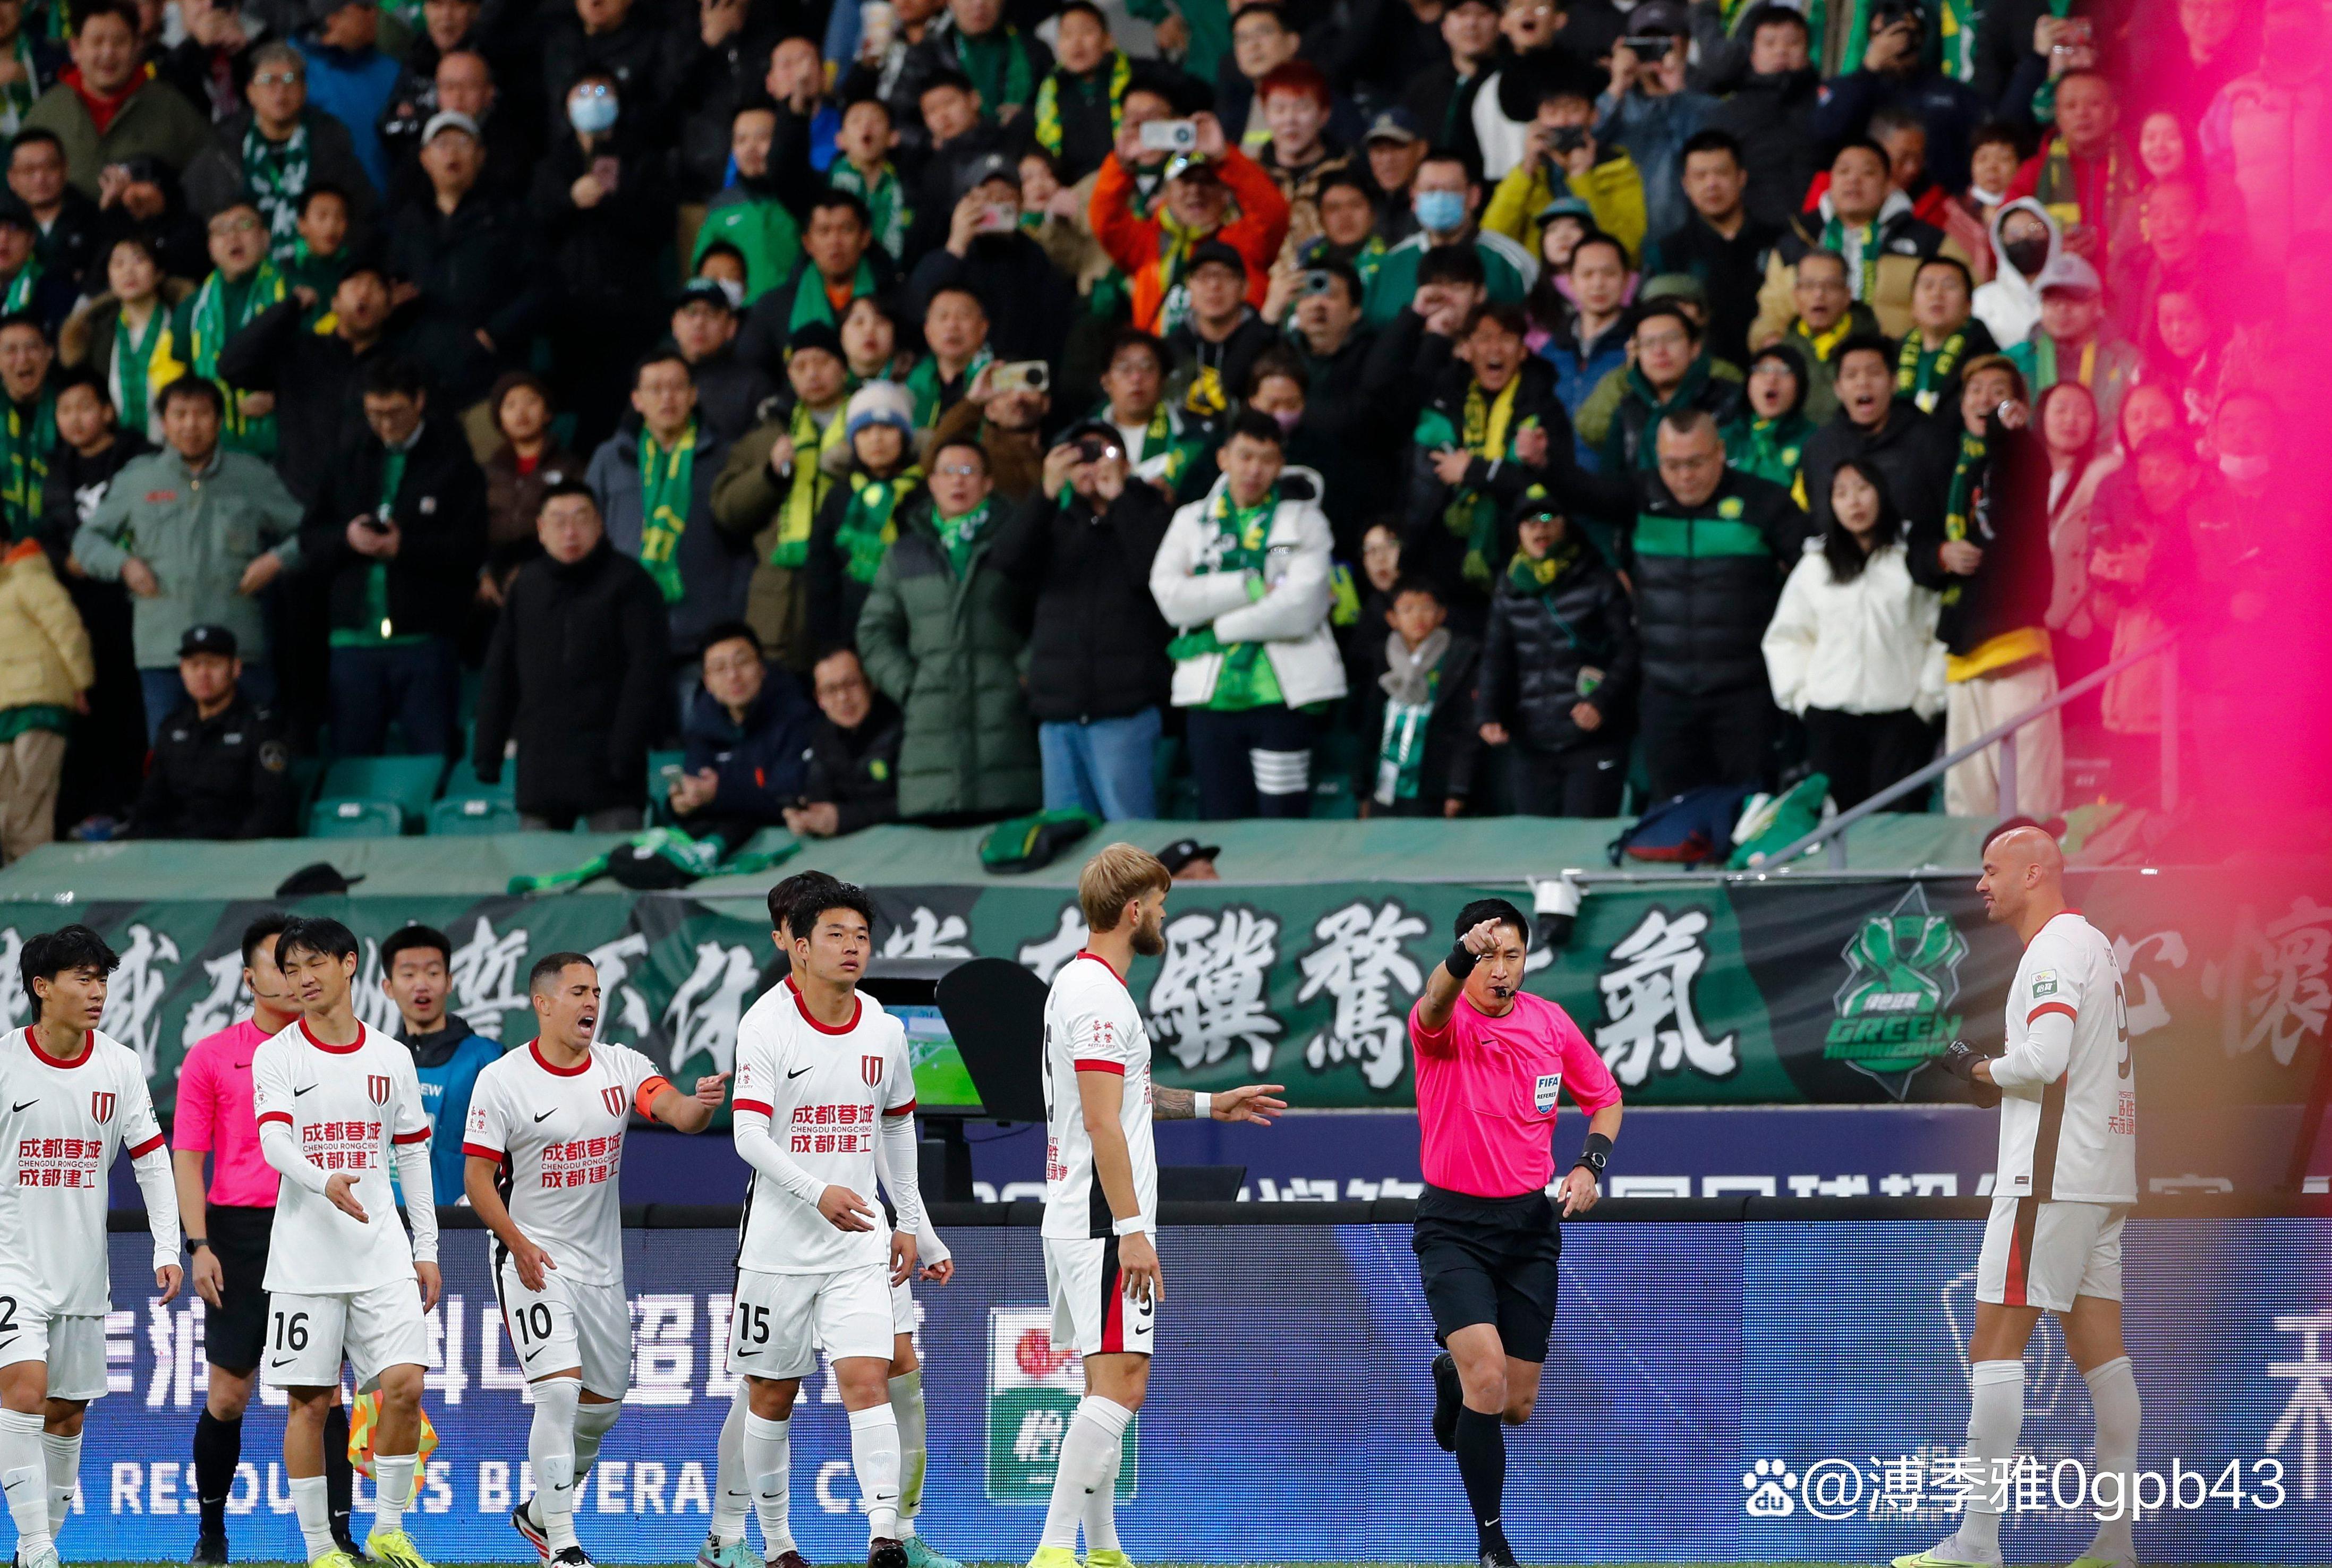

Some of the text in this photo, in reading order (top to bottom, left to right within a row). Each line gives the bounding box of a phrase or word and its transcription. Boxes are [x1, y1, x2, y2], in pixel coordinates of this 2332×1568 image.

[1825, 1013, 1963, 1043] GREEN
[1538, 1077, 1558, 1088] FIFA
[791, 1104, 875, 1124] 成都蓉城
[302, 1121, 382, 1143] 成都蓉城
[18, 1138, 103, 1160] 成都蓉城
[303, 1143, 338, 1152] CHENGDU
[541, 1132, 622, 1162] 成都蓉城
[790, 1134, 871, 1153] 成都建工
[305, 1151, 378, 1170] 成都建工
[541, 1151, 620, 1170] CHENGDU RONGCHENG
[18, 1169, 97, 1189] 成都建工
[541, 1158, 619, 1188] 成都建工
[274, 1311, 309, 1351] 16
[515, 1302, 553, 1345] 10
[739, 1302, 770, 1344] 15
